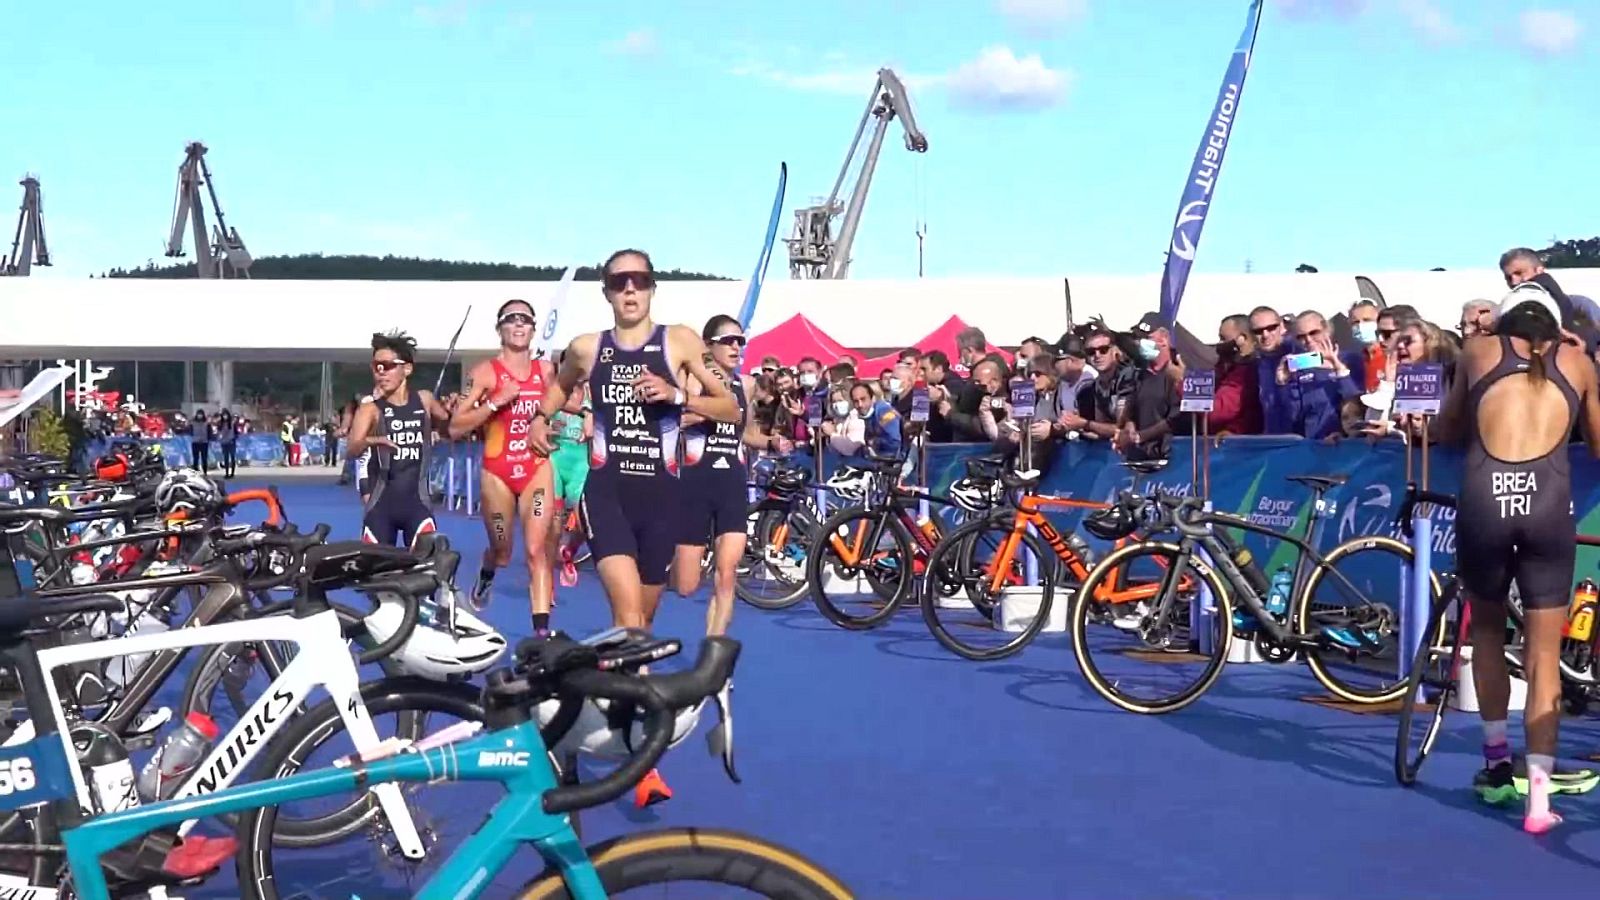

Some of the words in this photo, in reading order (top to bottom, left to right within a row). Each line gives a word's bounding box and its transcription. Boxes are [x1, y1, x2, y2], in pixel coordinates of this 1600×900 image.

[1396, 374, 1409, 390] 61
[615, 405, 647, 426] FRA
[393, 447, 420, 460] JPN
[1492, 471, 1538, 495] BREA
[1495, 494, 1532, 519] TRI
[478, 751, 531, 767] BMC
